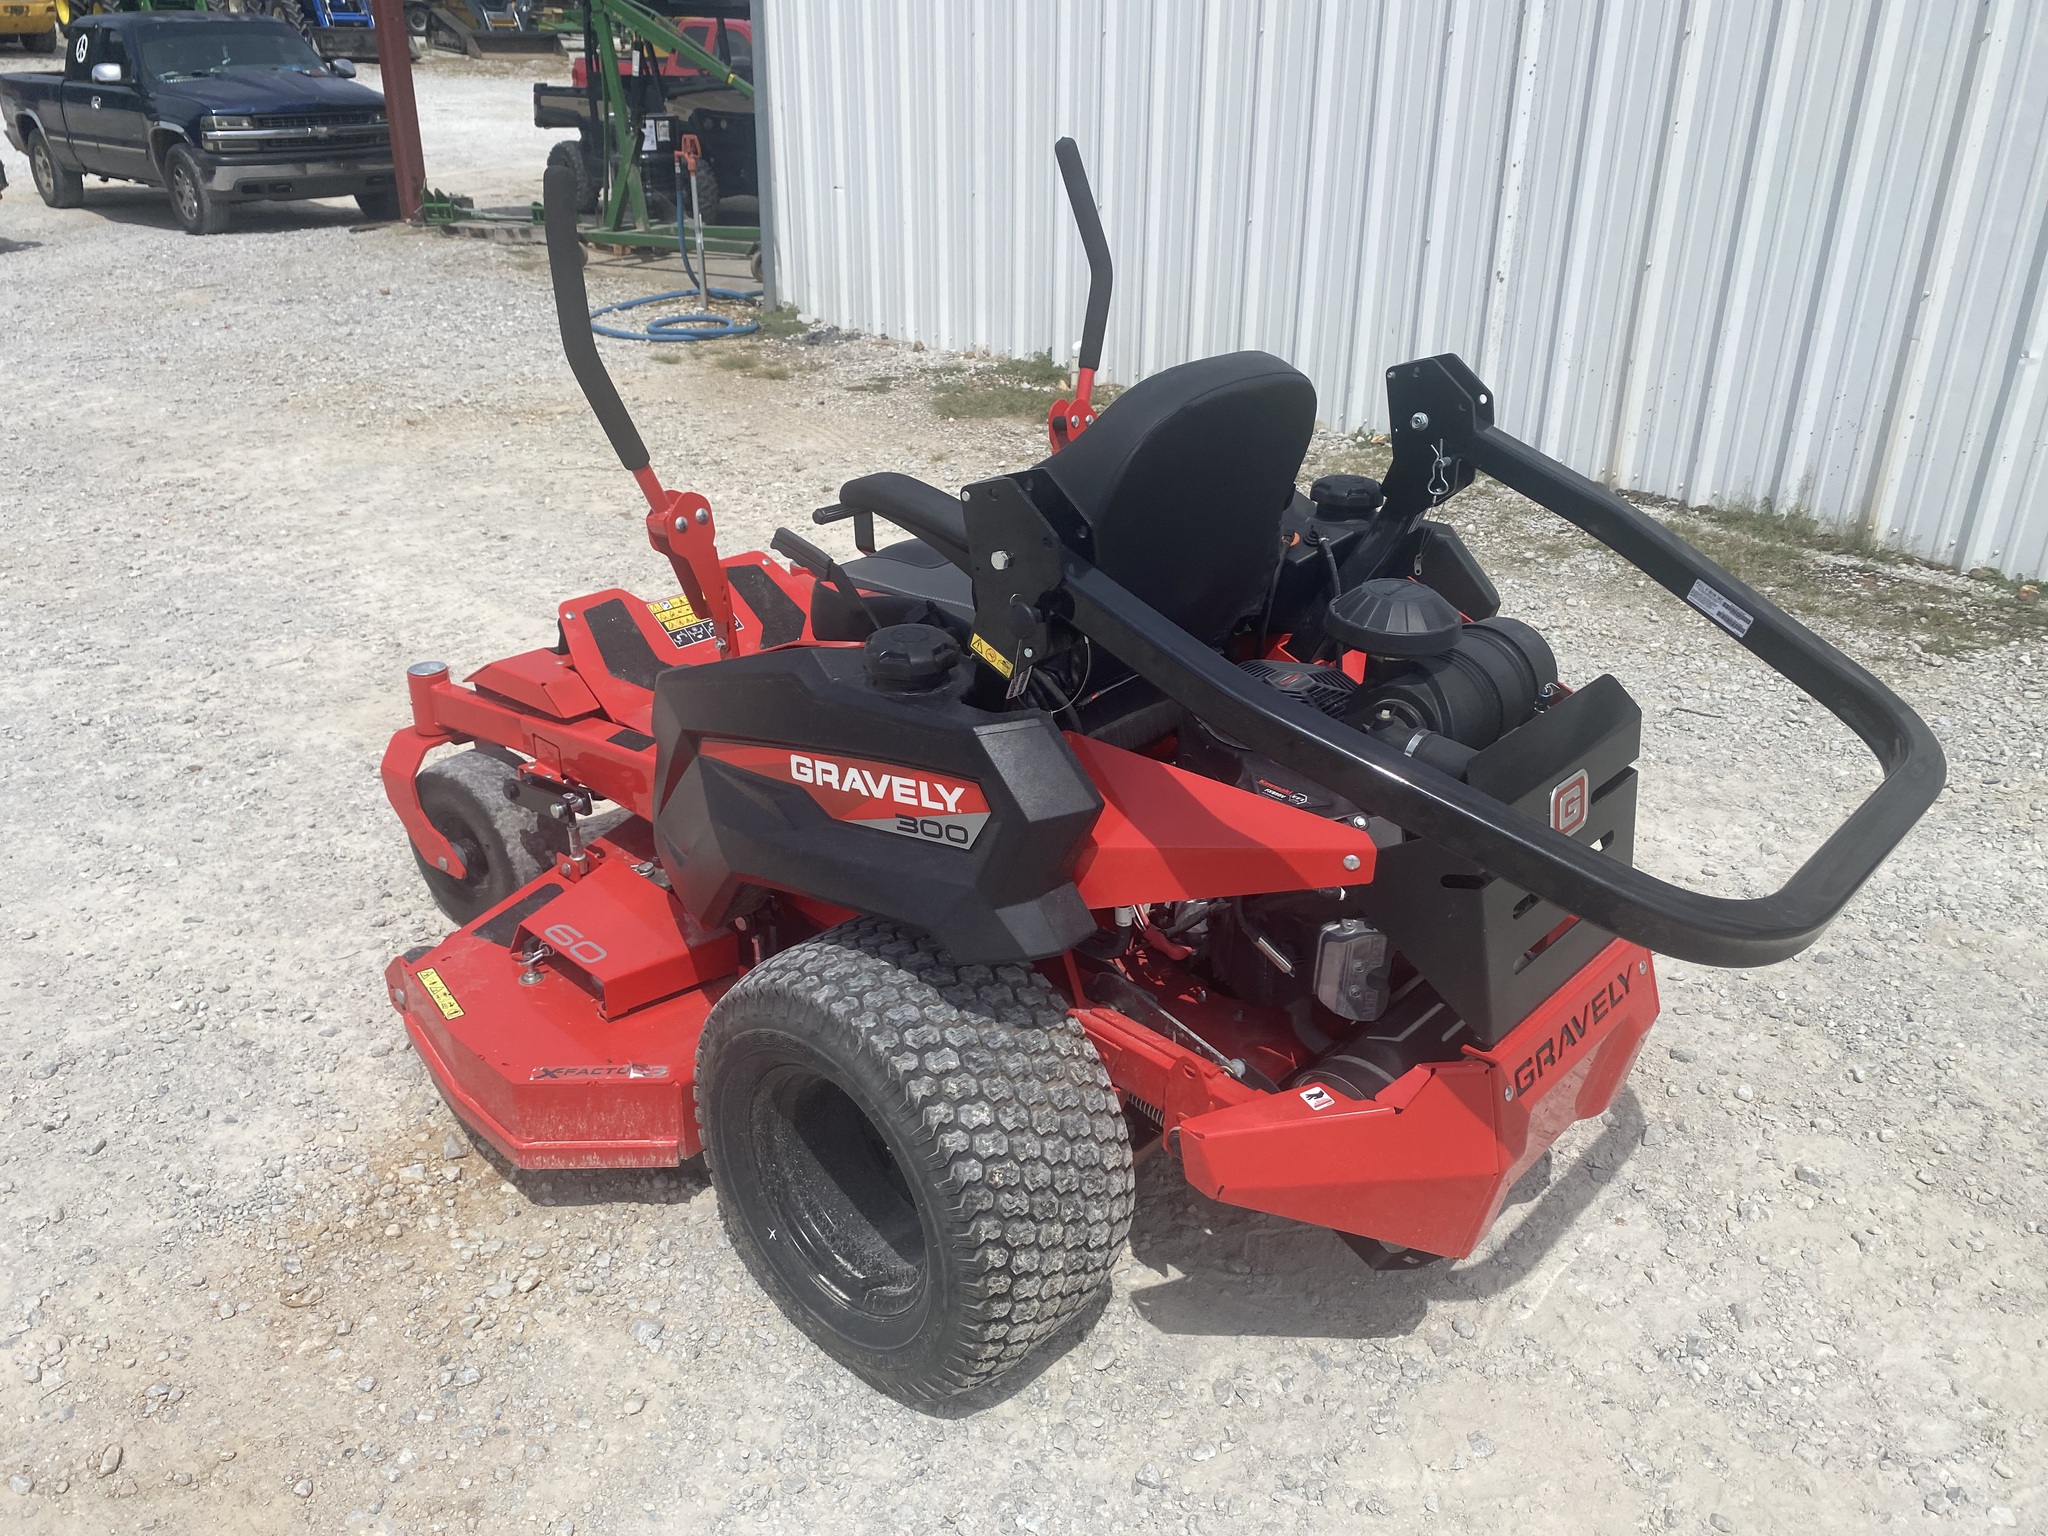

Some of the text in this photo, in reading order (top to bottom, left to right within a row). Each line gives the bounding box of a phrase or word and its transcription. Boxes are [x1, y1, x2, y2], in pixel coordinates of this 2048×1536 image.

[789, 753, 966, 813] GRAVELY
[894, 813, 969, 844] 300
[544, 924, 608, 964] 60
[1514, 962, 1635, 1098] GRAVELY
